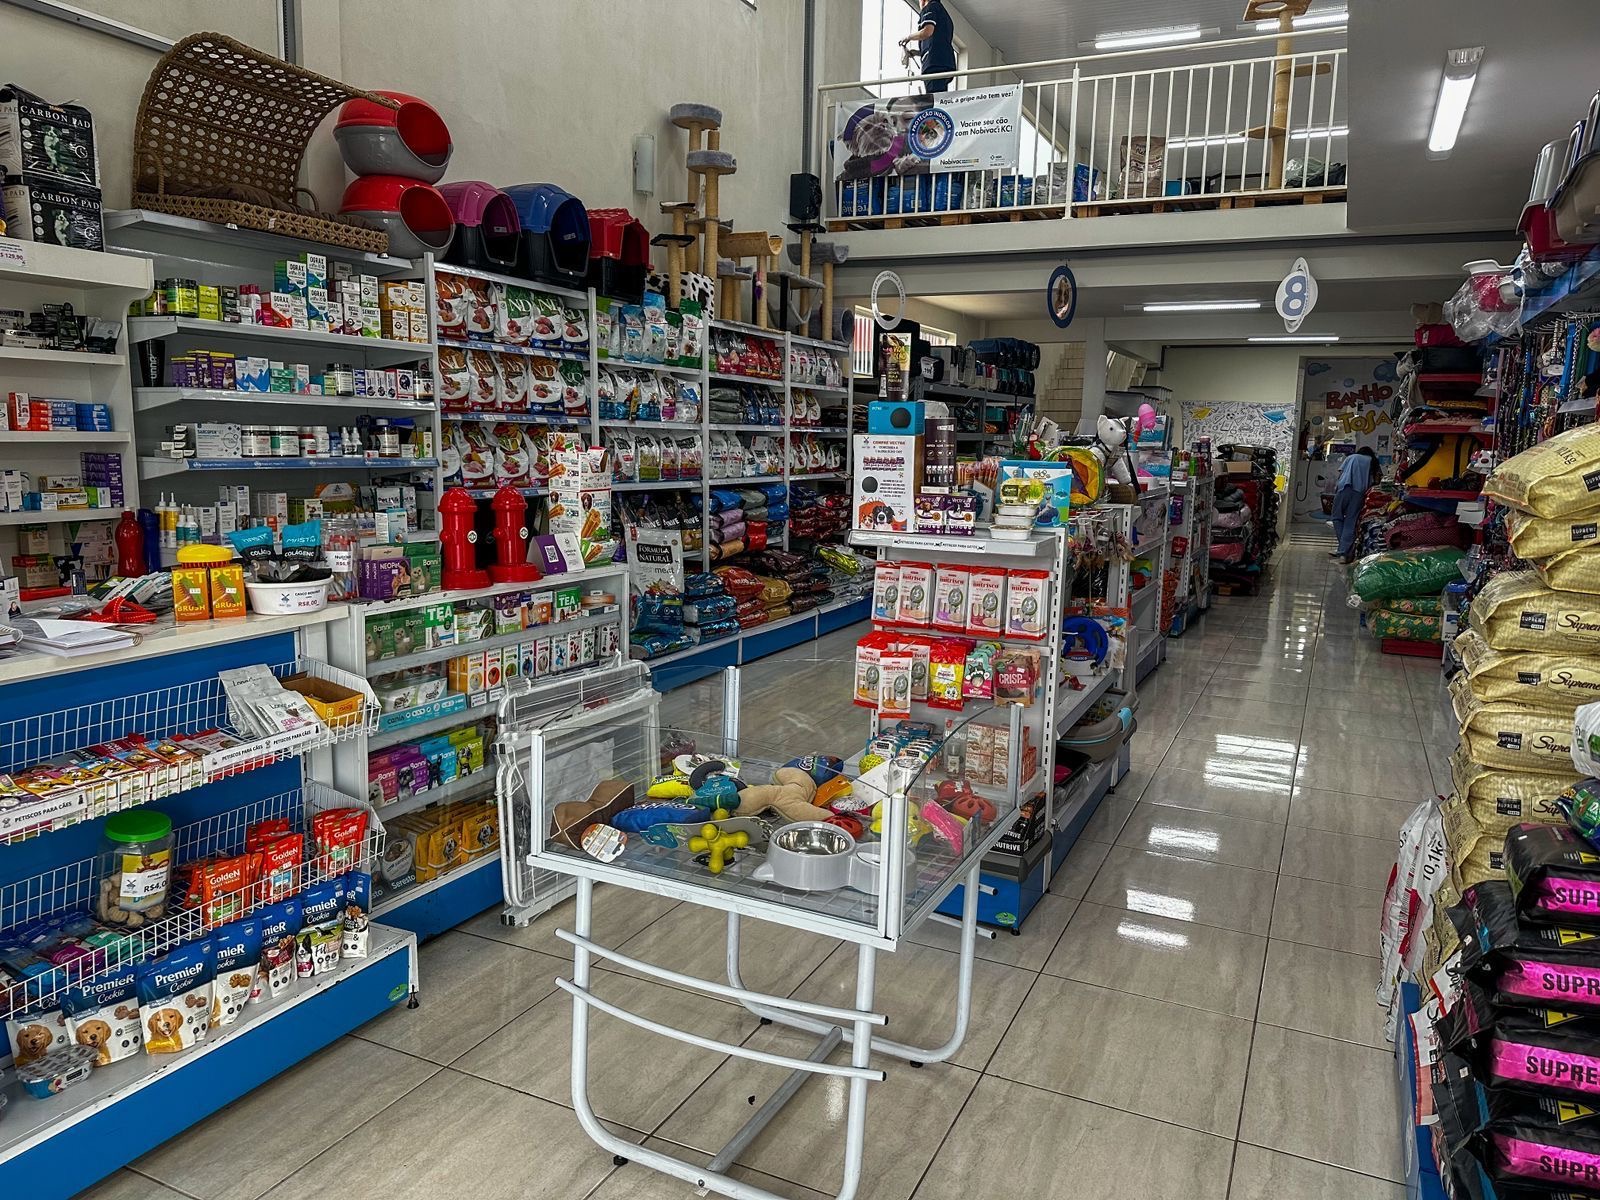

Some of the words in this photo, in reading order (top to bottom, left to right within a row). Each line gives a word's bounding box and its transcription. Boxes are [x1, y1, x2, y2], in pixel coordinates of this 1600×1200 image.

[20, 105, 68, 123] CARBON
[960, 120, 982, 128] Vacine
[31, 190, 77, 205] CARBON
[81, 199, 100, 210] PAD
[1326, 382, 1393, 410] BANHO
[1337, 409, 1393, 435] TOSA
[640, 555, 670, 563] NATURAL
[559, 596, 576, 607] TEA
[427, 606, 453, 621] TEA
[999, 673, 1023, 685] CRISP
[1550, 671, 1600, 690] Supreme
[222, 751, 241, 761] PETISCOS
[241, 747, 252, 755] PARA
[253, 744, 263, 752] CÃES
[273, 736, 291, 745] PETISCOS
[302, 729, 311, 737] CÃES
[14, 810, 42, 823] PETISCOS
[42, 805, 58, 816] PARA
[58, 799, 72, 811] CÃES
[271, 847, 299, 861] GoldeN
[209, 869, 241, 885] GoldeN
[391, 873, 416, 889] Seresto
[144, 880, 168, 893] R$4,0
[302, 898, 337, 915] remieR
[307, 912, 330, 924] Cookie
[262, 921, 287, 936] mieR
[217, 943, 245, 959] mieR
[217, 958, 235, 970] ookie
[155, 963, 204, 986] PremieR
[82, 974, 135, 997] PremieR
[170, 977, 194, 993] Cookie
[97, 989, 125, 1004] Cookie
[1526, 1055, 1598, 1085] SUPRE
